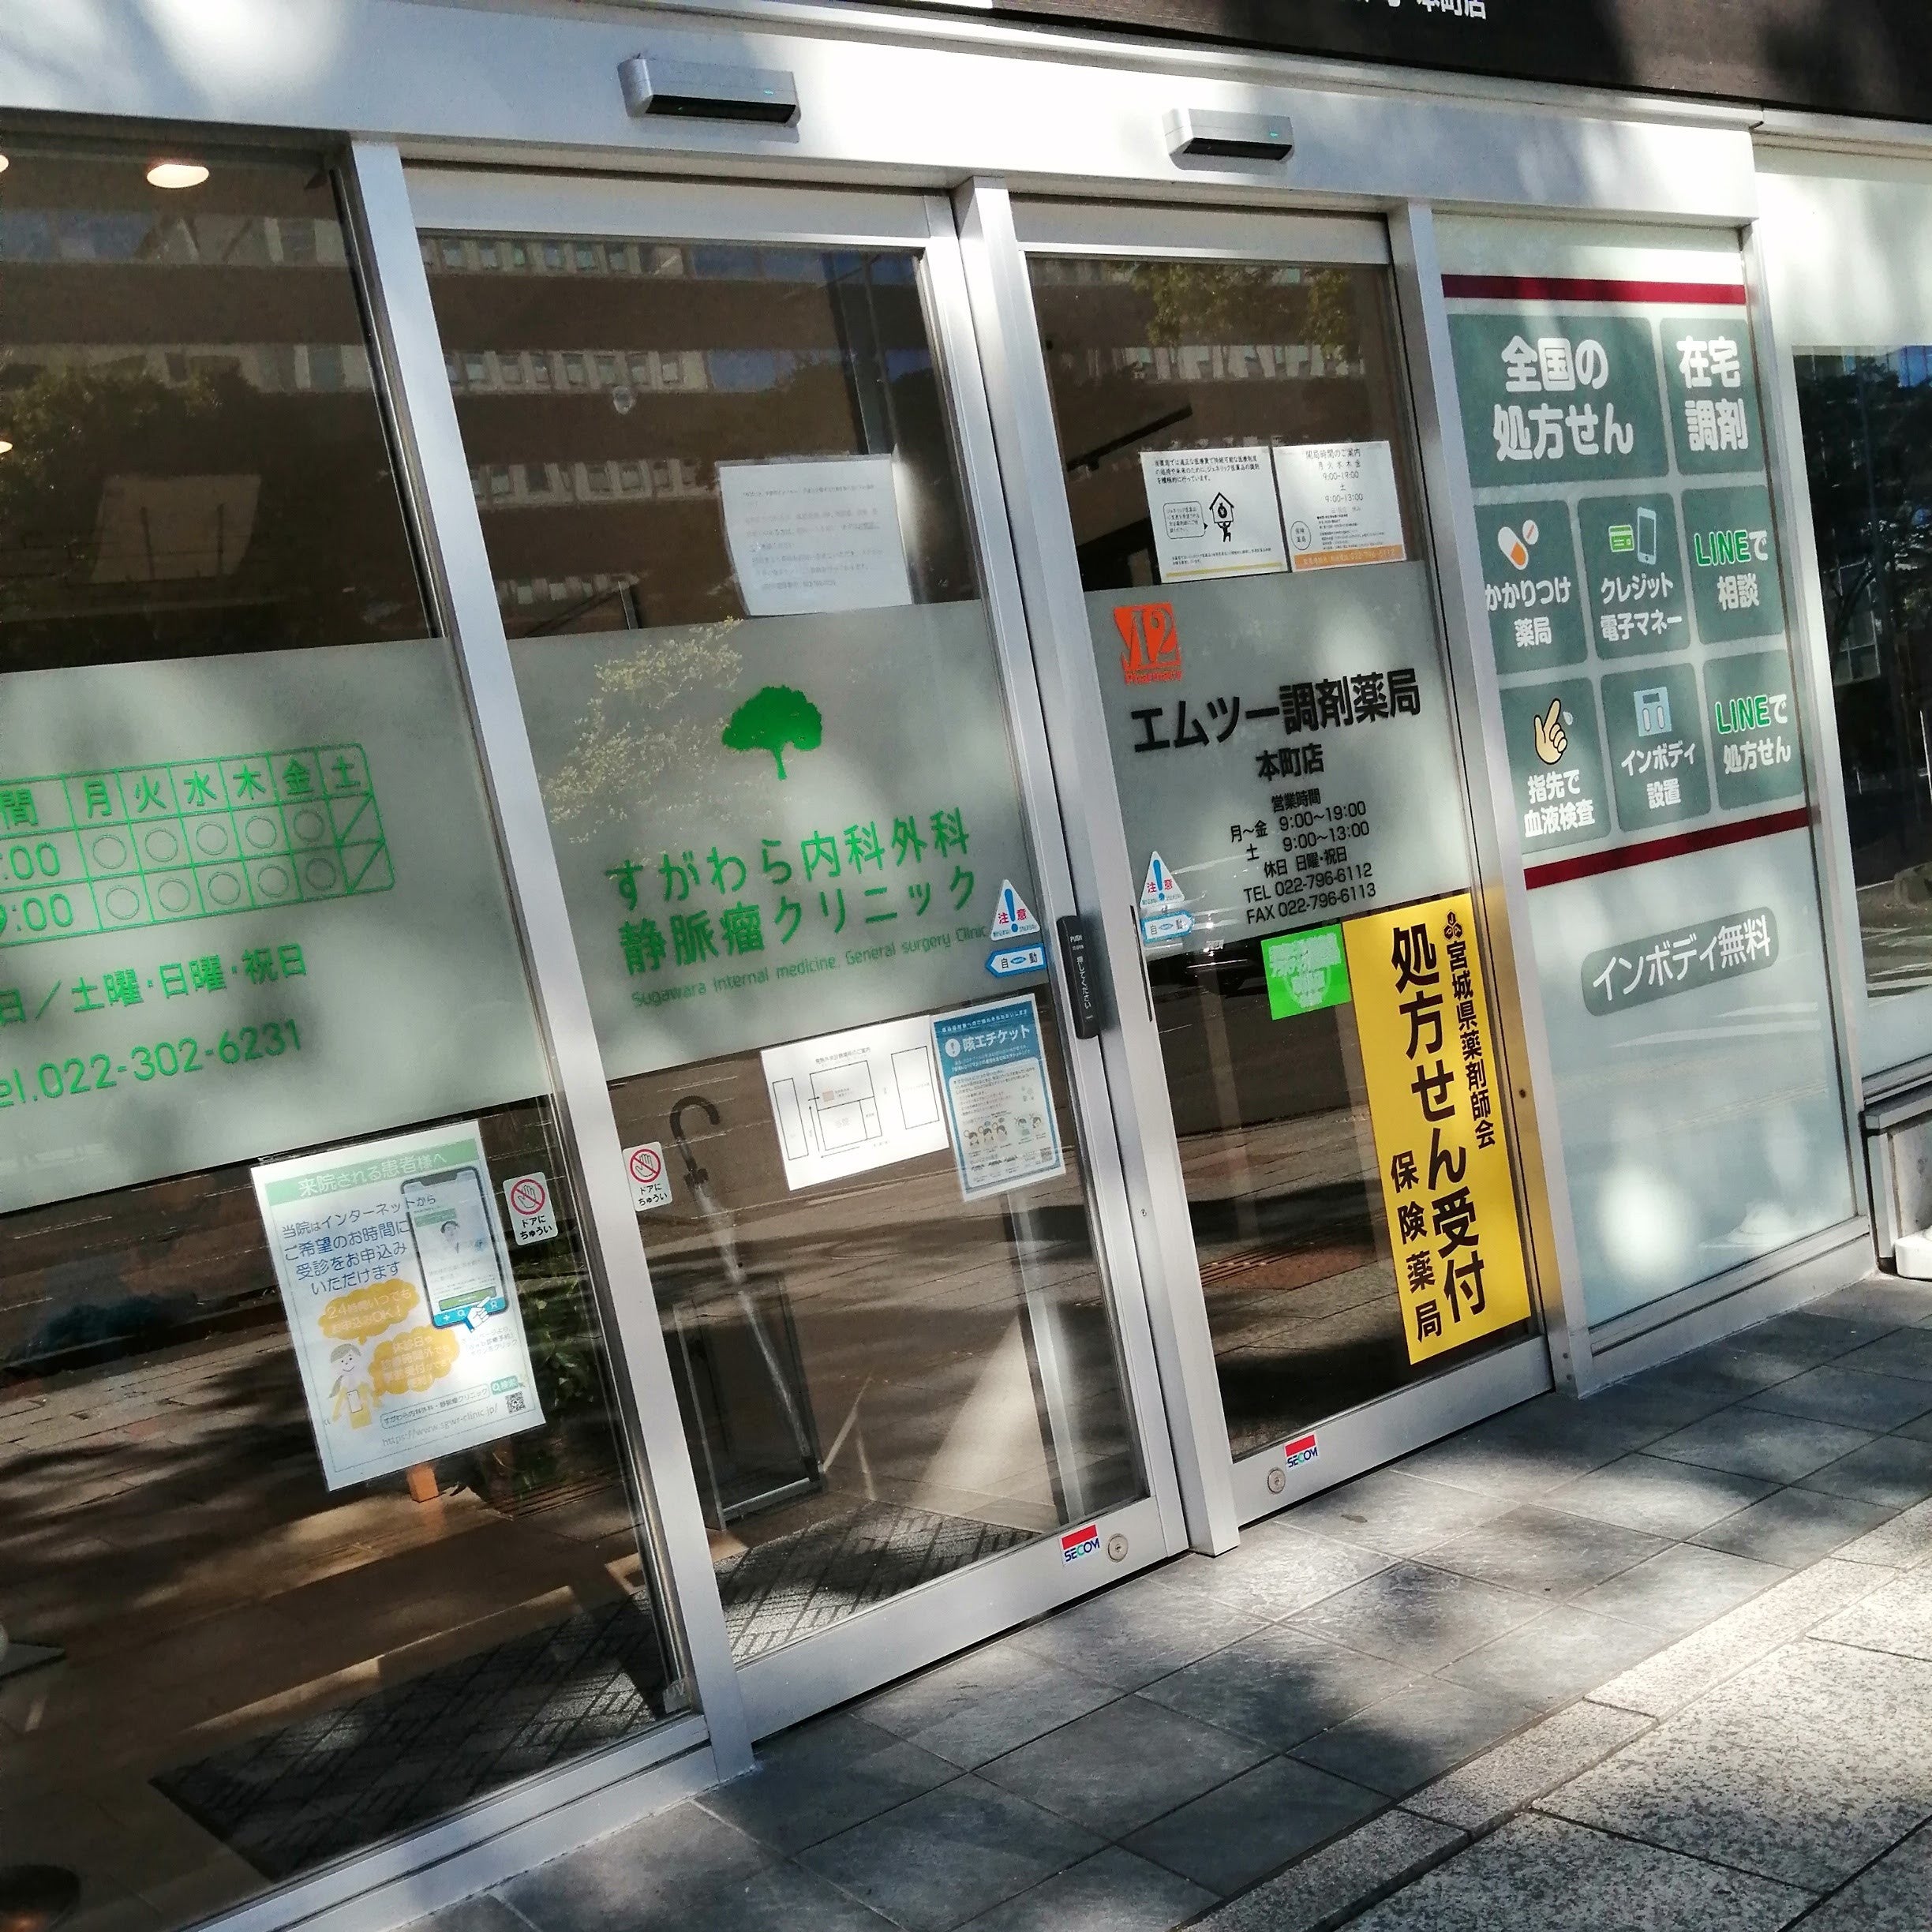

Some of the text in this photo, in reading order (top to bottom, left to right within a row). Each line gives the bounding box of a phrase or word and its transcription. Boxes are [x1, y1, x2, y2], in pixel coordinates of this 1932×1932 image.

[1501, 335, 1609, 392] 全国の
[1676, 335, 1741, 389] 在宅
[1492, 402, 1634, 462] 処方せん
[1684, 398, 1749, 451] 調剤
[1694, 530, 1769, 567] LINEで
[1485, 576, 1571, 612] かかりつけ
[1601, 572, 1674, 605] クレジット
[1717, 573, 1759, 611] 相談
[1514, 616, 1552, 648] 薬局
[1601, 609, 1682, 642] 電子マネー
[1130, 668, 1421, 753] エムツー調剤薬局
[1714, 694, 1788, 735] LINEで
[1256, 743, 1325, 781] 本町店
[1621, 741, 1696, 777] インボディ
[1723, 736, 1792, 775] 処方せん
[83, 779, 112, 818] 月
[133, 778, 166, 813] 火
[184, 771, 217, 807] 水
[234, 765, 266, 799] 木
[283, 758, 315, 793] 金
[331, 756, 361, 788] 土
[1271, 788, 1321, 814] 営業時間
[1527, 770, 1581, 804] 指先で
[1646, 778, 1681, 809] 設置
[1524, 799, 1595, 838] 血液検査
[605, 806, 970, 911] すがわら内科外科
[1245, 843, 1261, 862] 土
[1264, 859, 1288, 879] 休日
[1244, 862, 1372, 904] TEL 022-796-6112
[619, 865, 975, 977] 静脈瘤クリニック
[1246, 882, 1376, 925] FAX 022-796-6113
[846, 942, 897, 966] General
[1593, 914, 1771, 1001] インボディ無料
[963, 1024, 1031, 1054] 咳エチケット
[1446, 940, 1496, 1151] 宮城県薬剤師会
[1391, 923, 1485, 1326] 処方せん受付
[298, 1153, 447, 1199] 来院される患者様へ
[639, 1183, 663, 1196] ドアに
[282, 1194, 436, 1239] 当院はインターネットから
[638, 1193, 668, 1207] ちゅうい
[519, 1226, 553, 1241] ちゅうい
[521, 1215, 546, 1228] ドアに
[284, 1220, 411, 1262] ご希望のお時間に
[1391, 1149, 1444, 1343] 保険薬局
[295, 1241, 407, 1282] 受診をお申込み
[310, 1260, 399, 1296] いただけます
[1286, 1447, 1318, 1468] SECOM
[1065, 1537, 1100, 1562] SECOM
